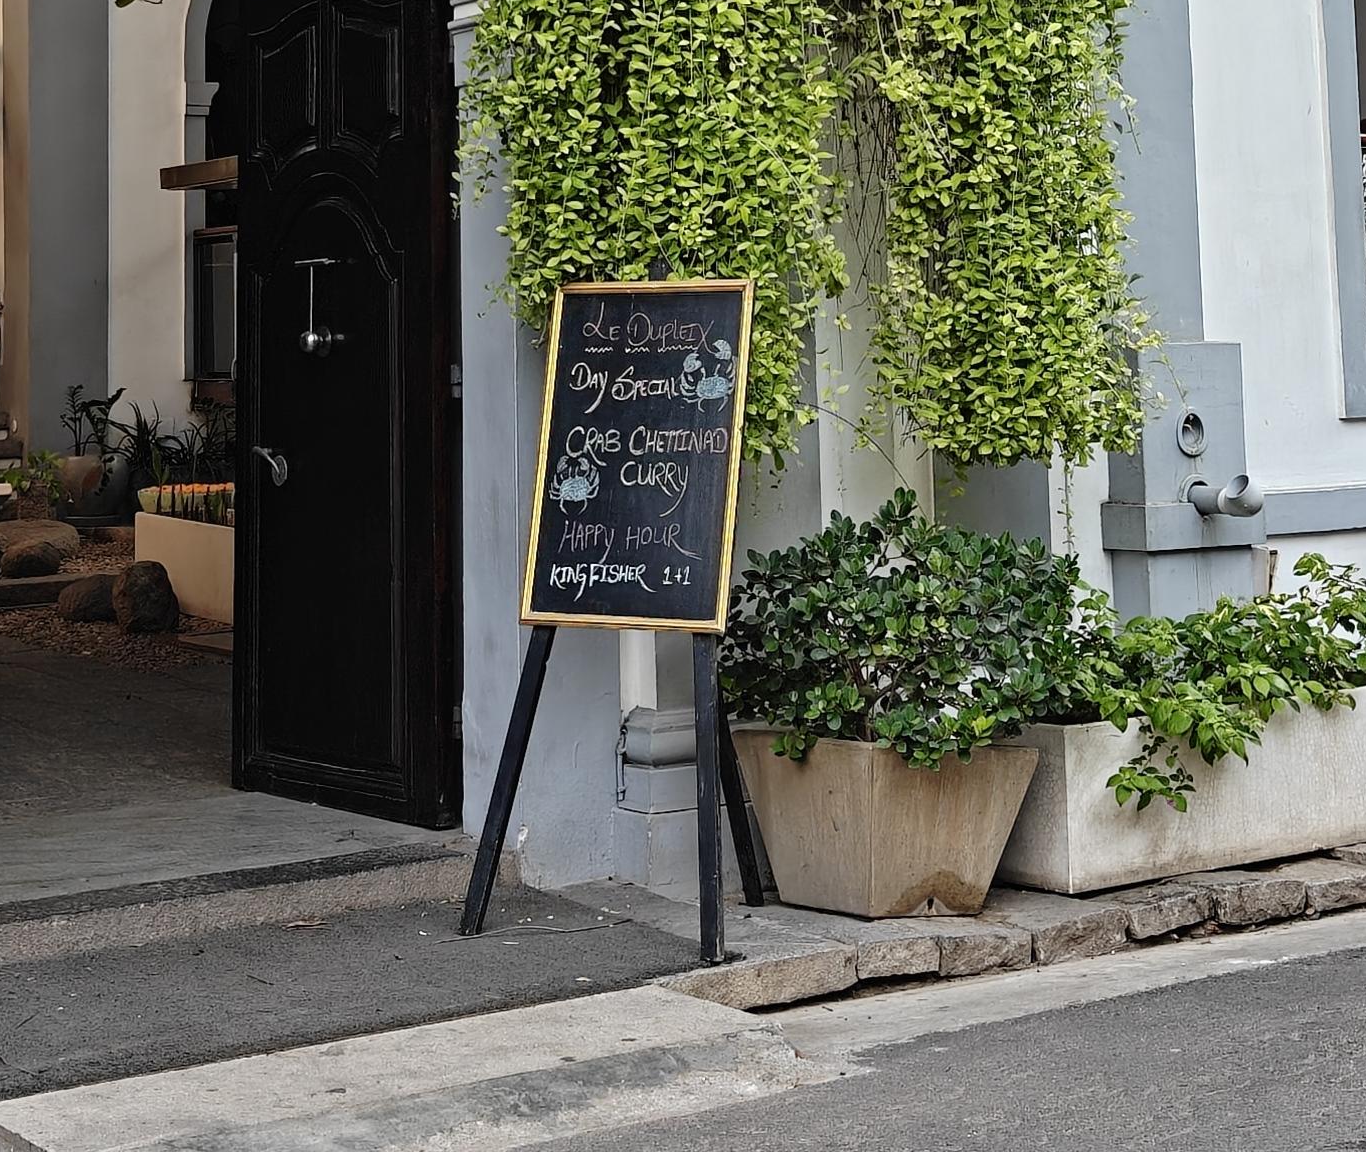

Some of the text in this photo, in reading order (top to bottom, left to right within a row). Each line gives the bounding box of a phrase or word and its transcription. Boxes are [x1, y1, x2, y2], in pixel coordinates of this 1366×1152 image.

[611, 365, 680, 401] SPECIAL
[566, 425, 728, 466] CRAB CHETTINAD
[620, 461, 689, 518] CURRY
[557, 520, 703, 564] HAPPY HOUR
[662, 566, 691, 586] 1+1
